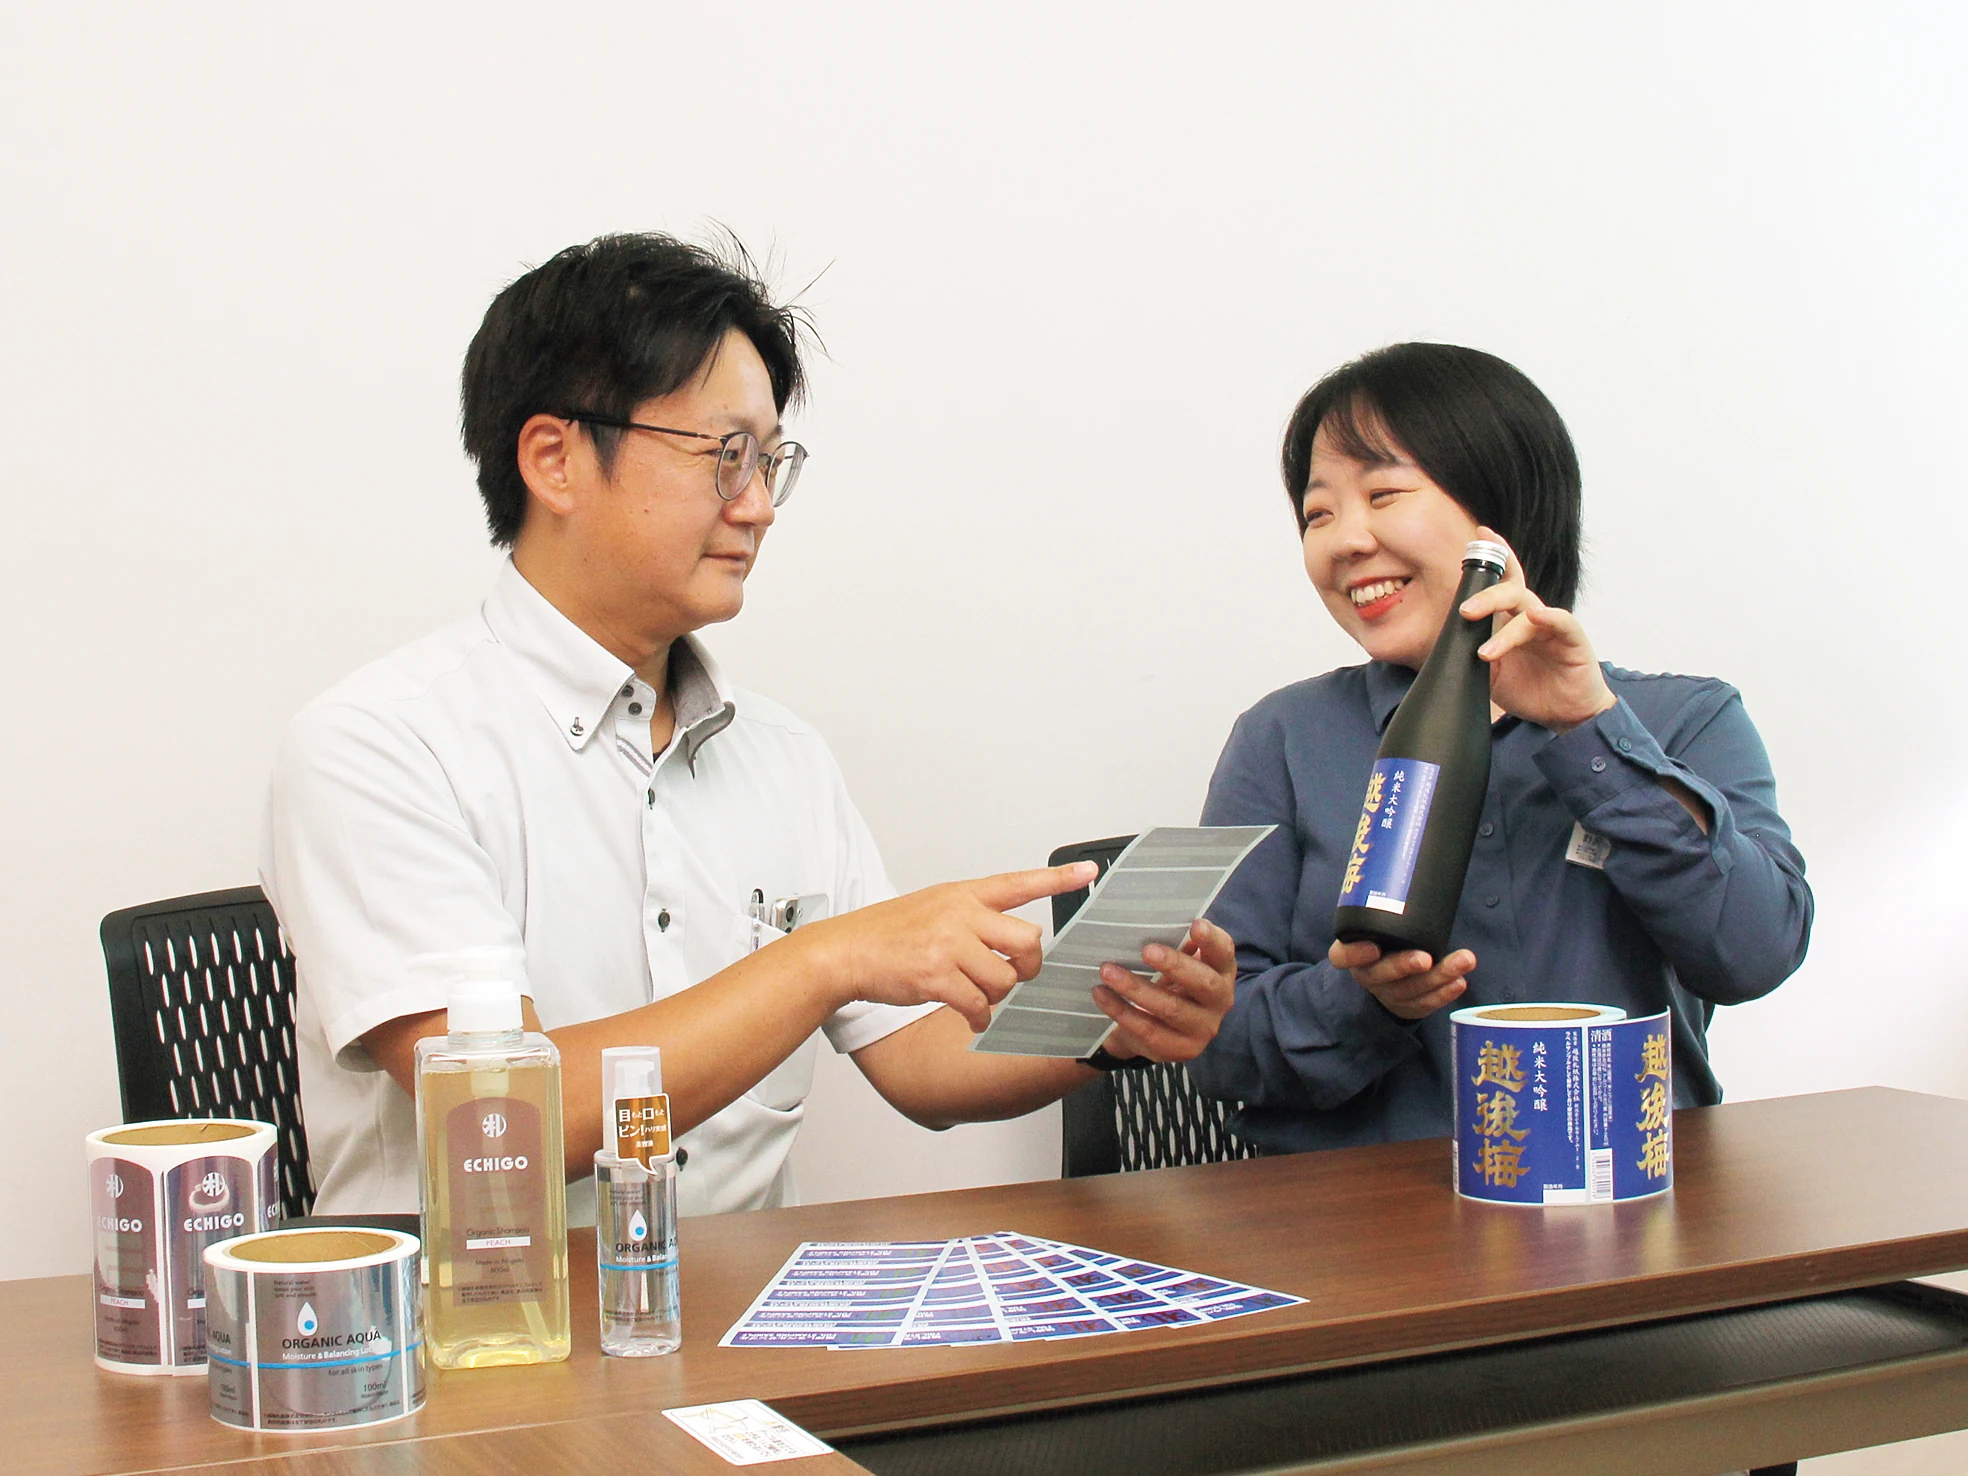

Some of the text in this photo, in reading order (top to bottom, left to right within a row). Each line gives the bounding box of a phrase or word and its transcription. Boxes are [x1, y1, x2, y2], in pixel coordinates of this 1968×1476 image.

[463, 1156, 529, 1172] ECHIGO
[97, 1215, 143, 1233] ECHIGO
[183, 1212, 245, 1232] ECHIGO
[615, 1240, 666, 1253] ORGANIC
[213, 1330, 231, 1344] AQUA
[282, 1330, 381, 1349] ORGANIC AQUA
[323, 1349, 360, 1358] Balancing
